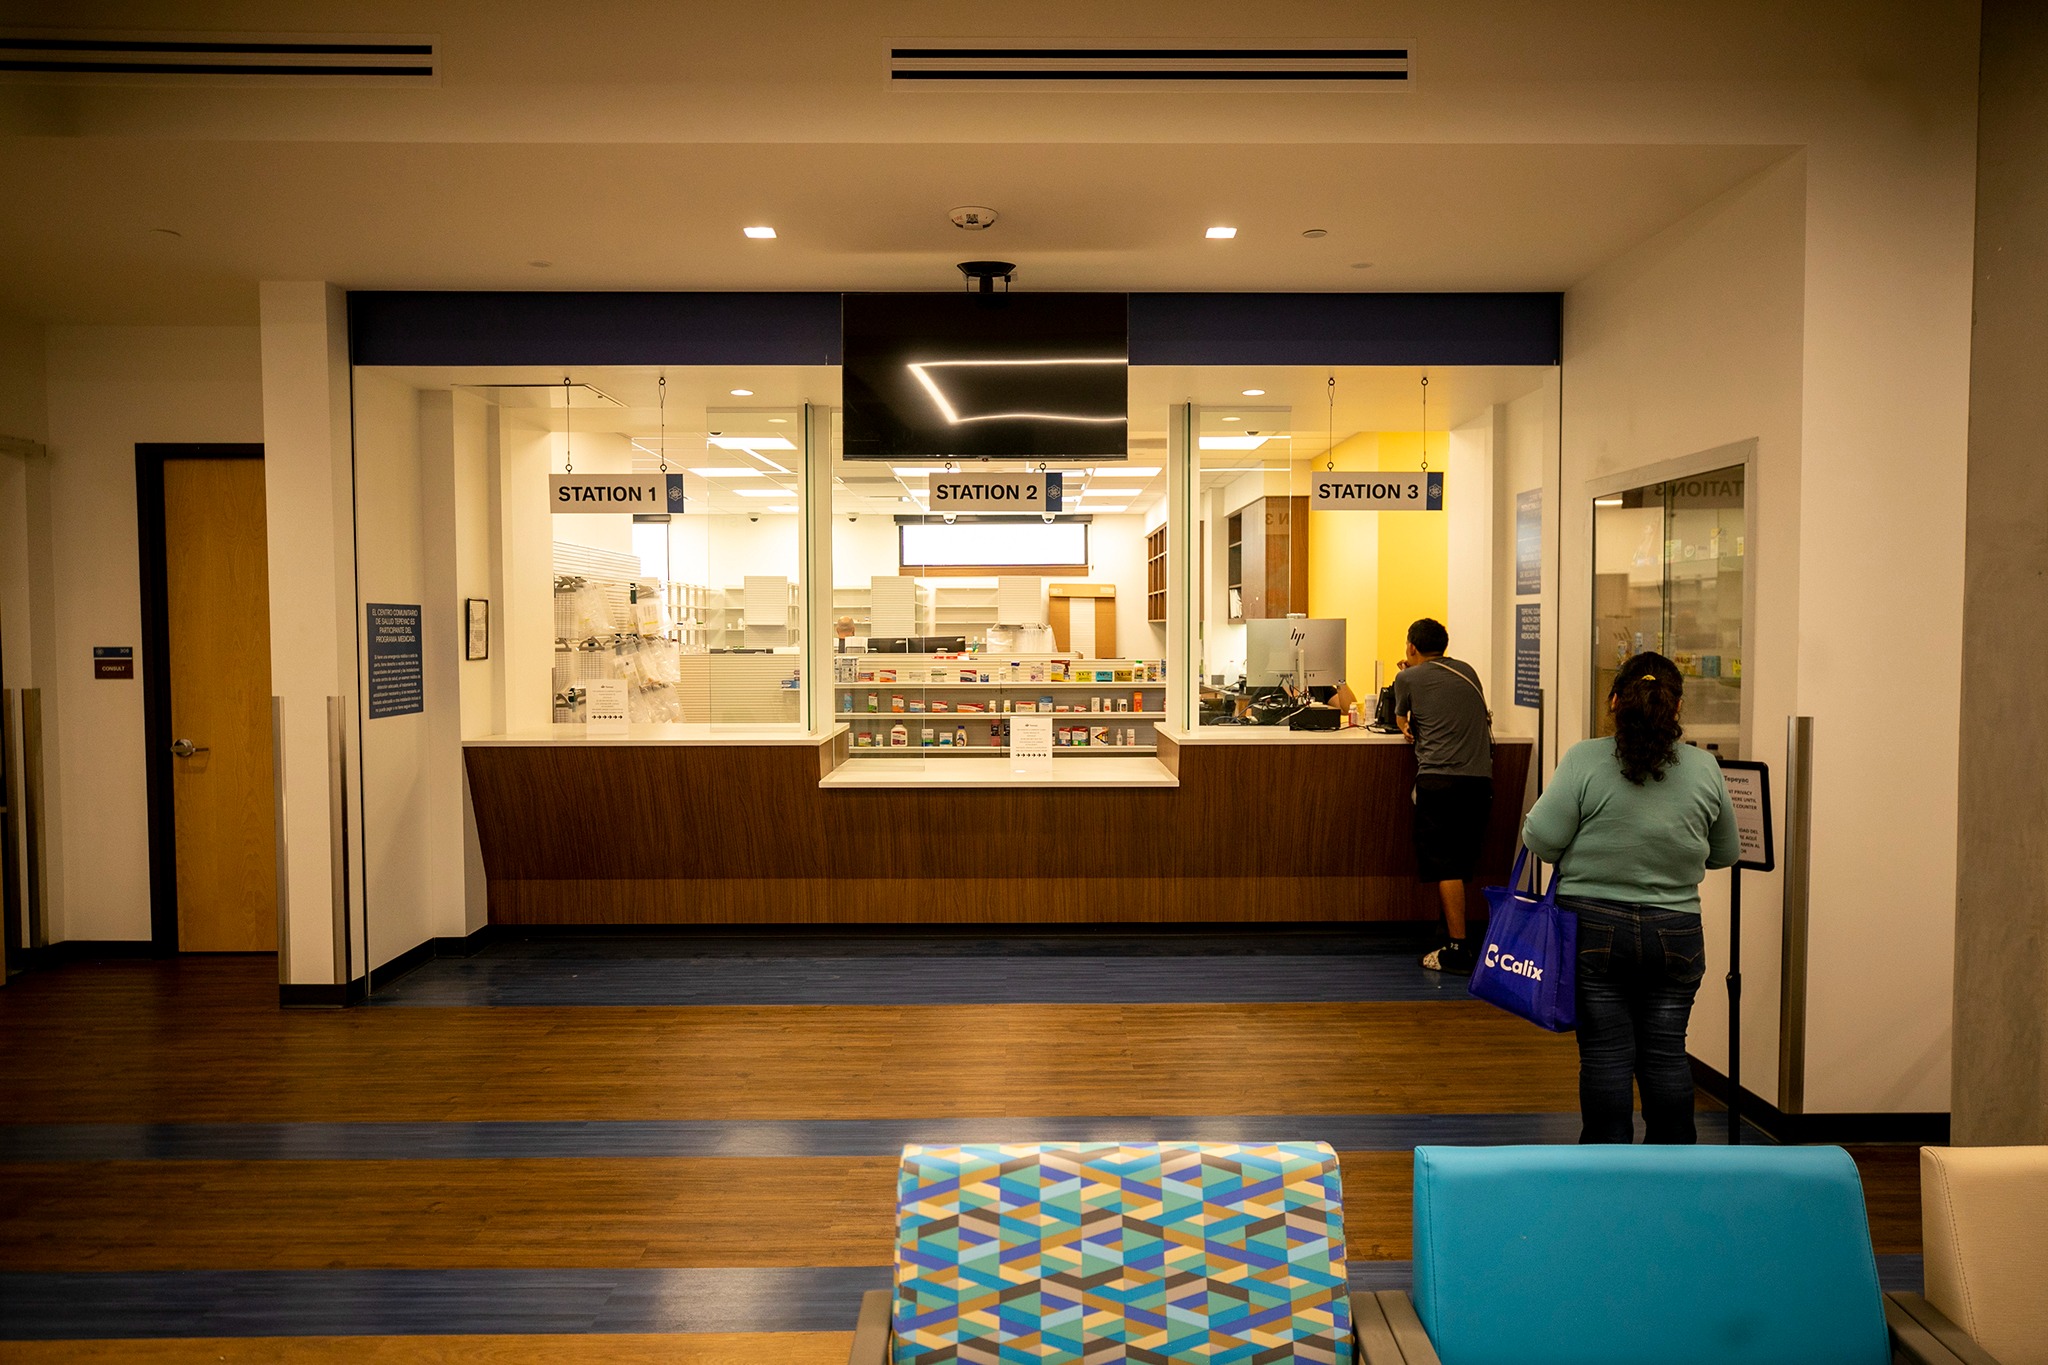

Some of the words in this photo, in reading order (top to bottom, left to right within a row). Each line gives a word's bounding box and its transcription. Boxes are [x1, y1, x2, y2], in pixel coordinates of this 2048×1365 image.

[558, 486, 642, 502] STATION
[648, 486, 656, 501] 1
[936, 484, 1019, 500] STATION
[1026, 484, 1038, 500] 2
[1318, 483, 1401, 499] STATION
[1407, 484, 1419, 499] 3
[1500, 953, 1544, 981] Calix
